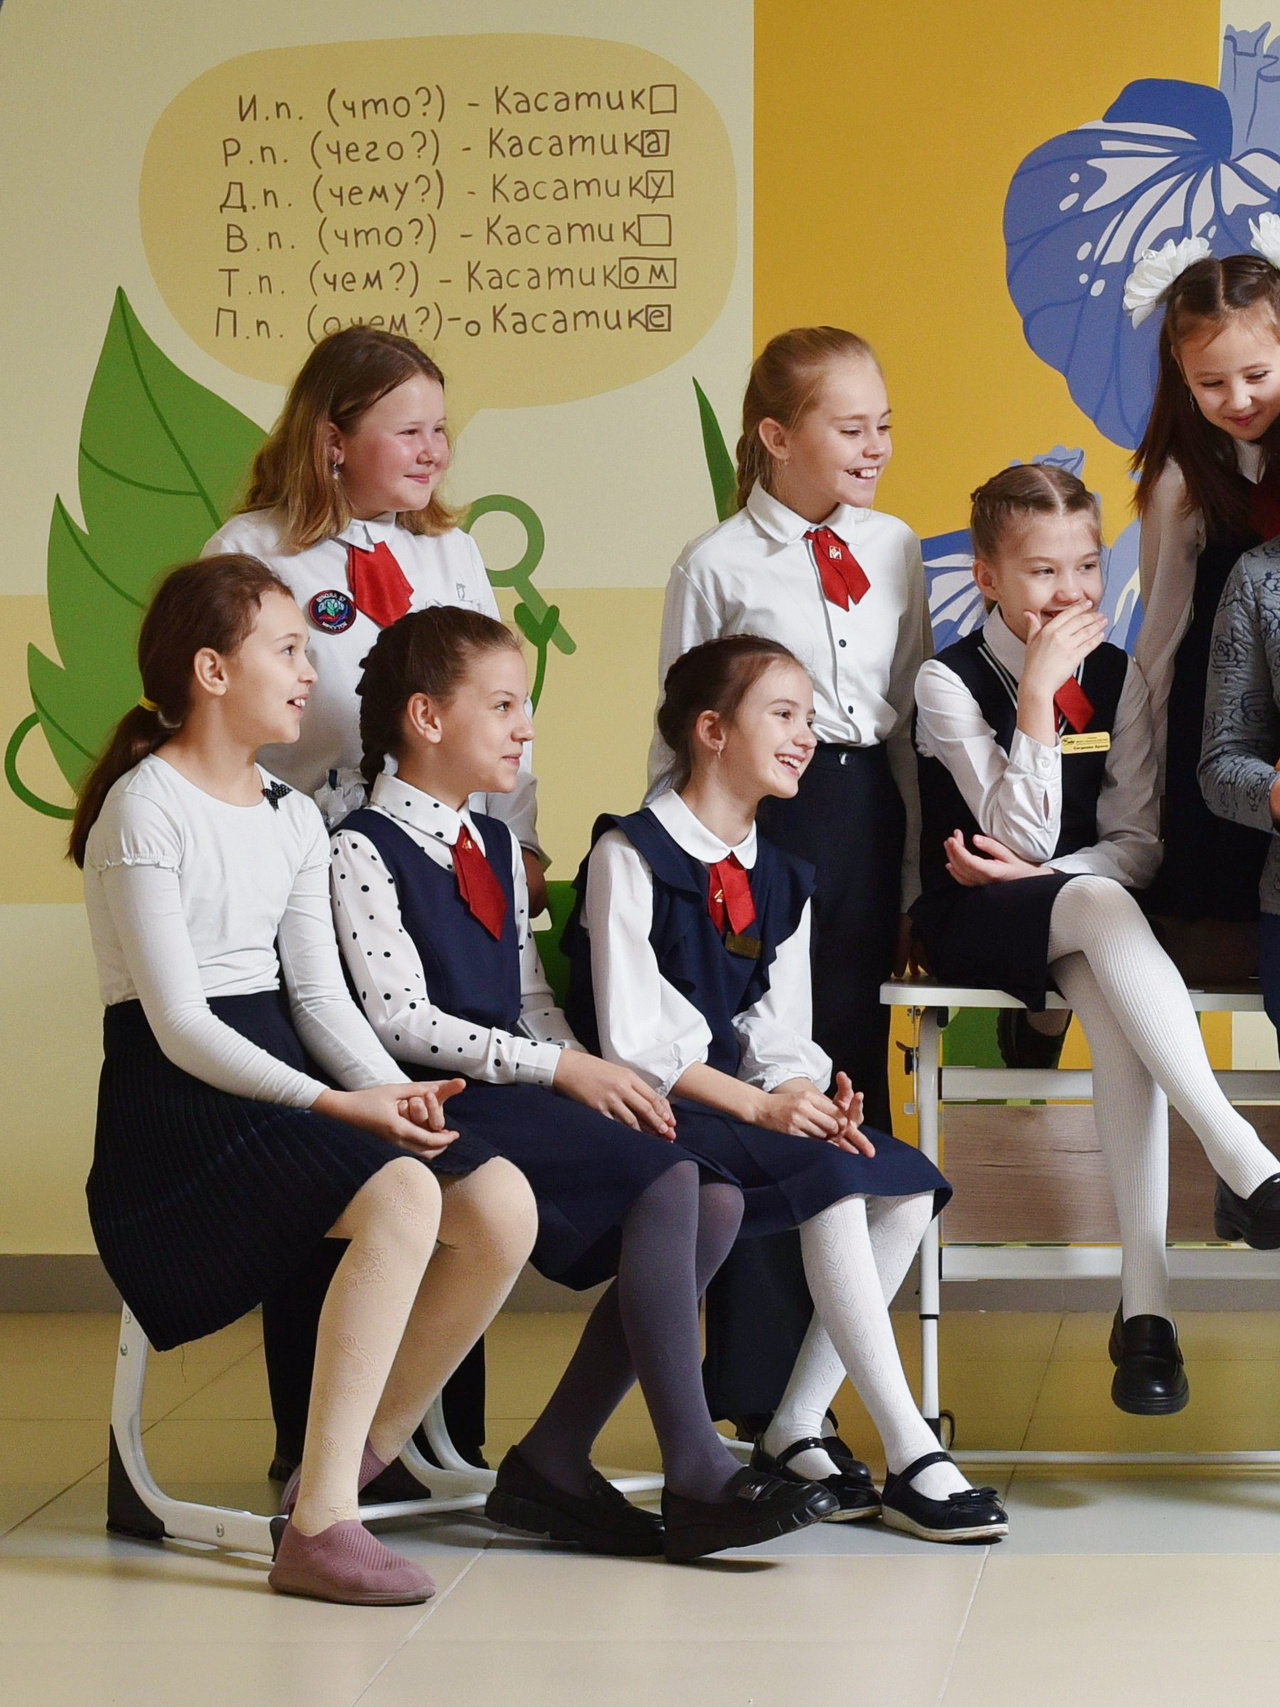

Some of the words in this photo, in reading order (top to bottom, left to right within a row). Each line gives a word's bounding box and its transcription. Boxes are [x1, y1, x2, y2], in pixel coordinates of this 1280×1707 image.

[327, 84, 446, 128] (что?)
[494, 84, 647, 116] Касатик
[310, 128, 440, 170] (чего?)
[488, 126, 668, 159] Касатика
[312, 168, 445, 214] (чему?)
[492, 172, 671, 205] Касатику
[318, 213, 437, 256] (что?)
[486, 213, 640, 246] Касатик
[309, 259, 419, 298] (чем?)
[467, 260, 671, 293] Касатиком
[492, 302, 668, 334] Касатике
